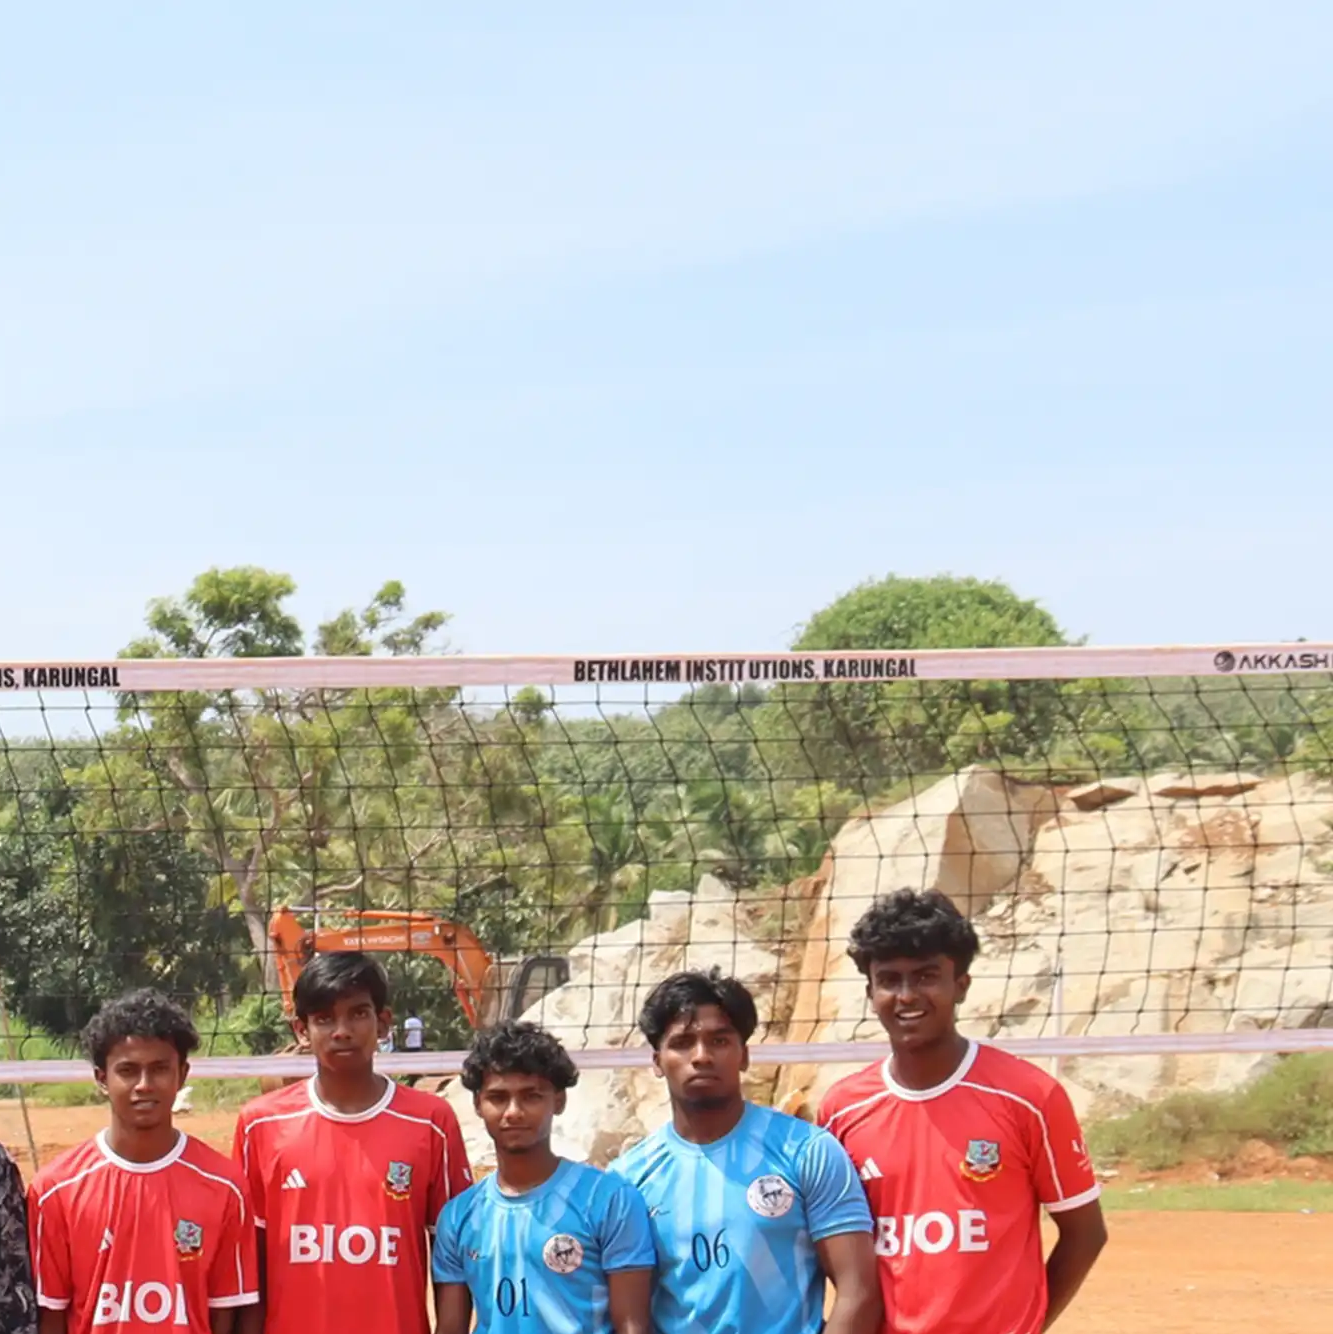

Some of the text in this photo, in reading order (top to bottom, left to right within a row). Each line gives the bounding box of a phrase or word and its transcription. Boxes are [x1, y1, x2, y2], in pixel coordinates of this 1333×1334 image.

[23, 666, 121, 688] KARUNGAL
[574, 660, 681, 682] BETHLAHEM
[824, 658, 918, 679] KARUNGAL
[289, 1223, 402, 1266] BIOE
[692, 1227, 730, 1273] 06
[875, 1209, 990, 1257] BIOE
[496, 1276, 530, 1317] 01
